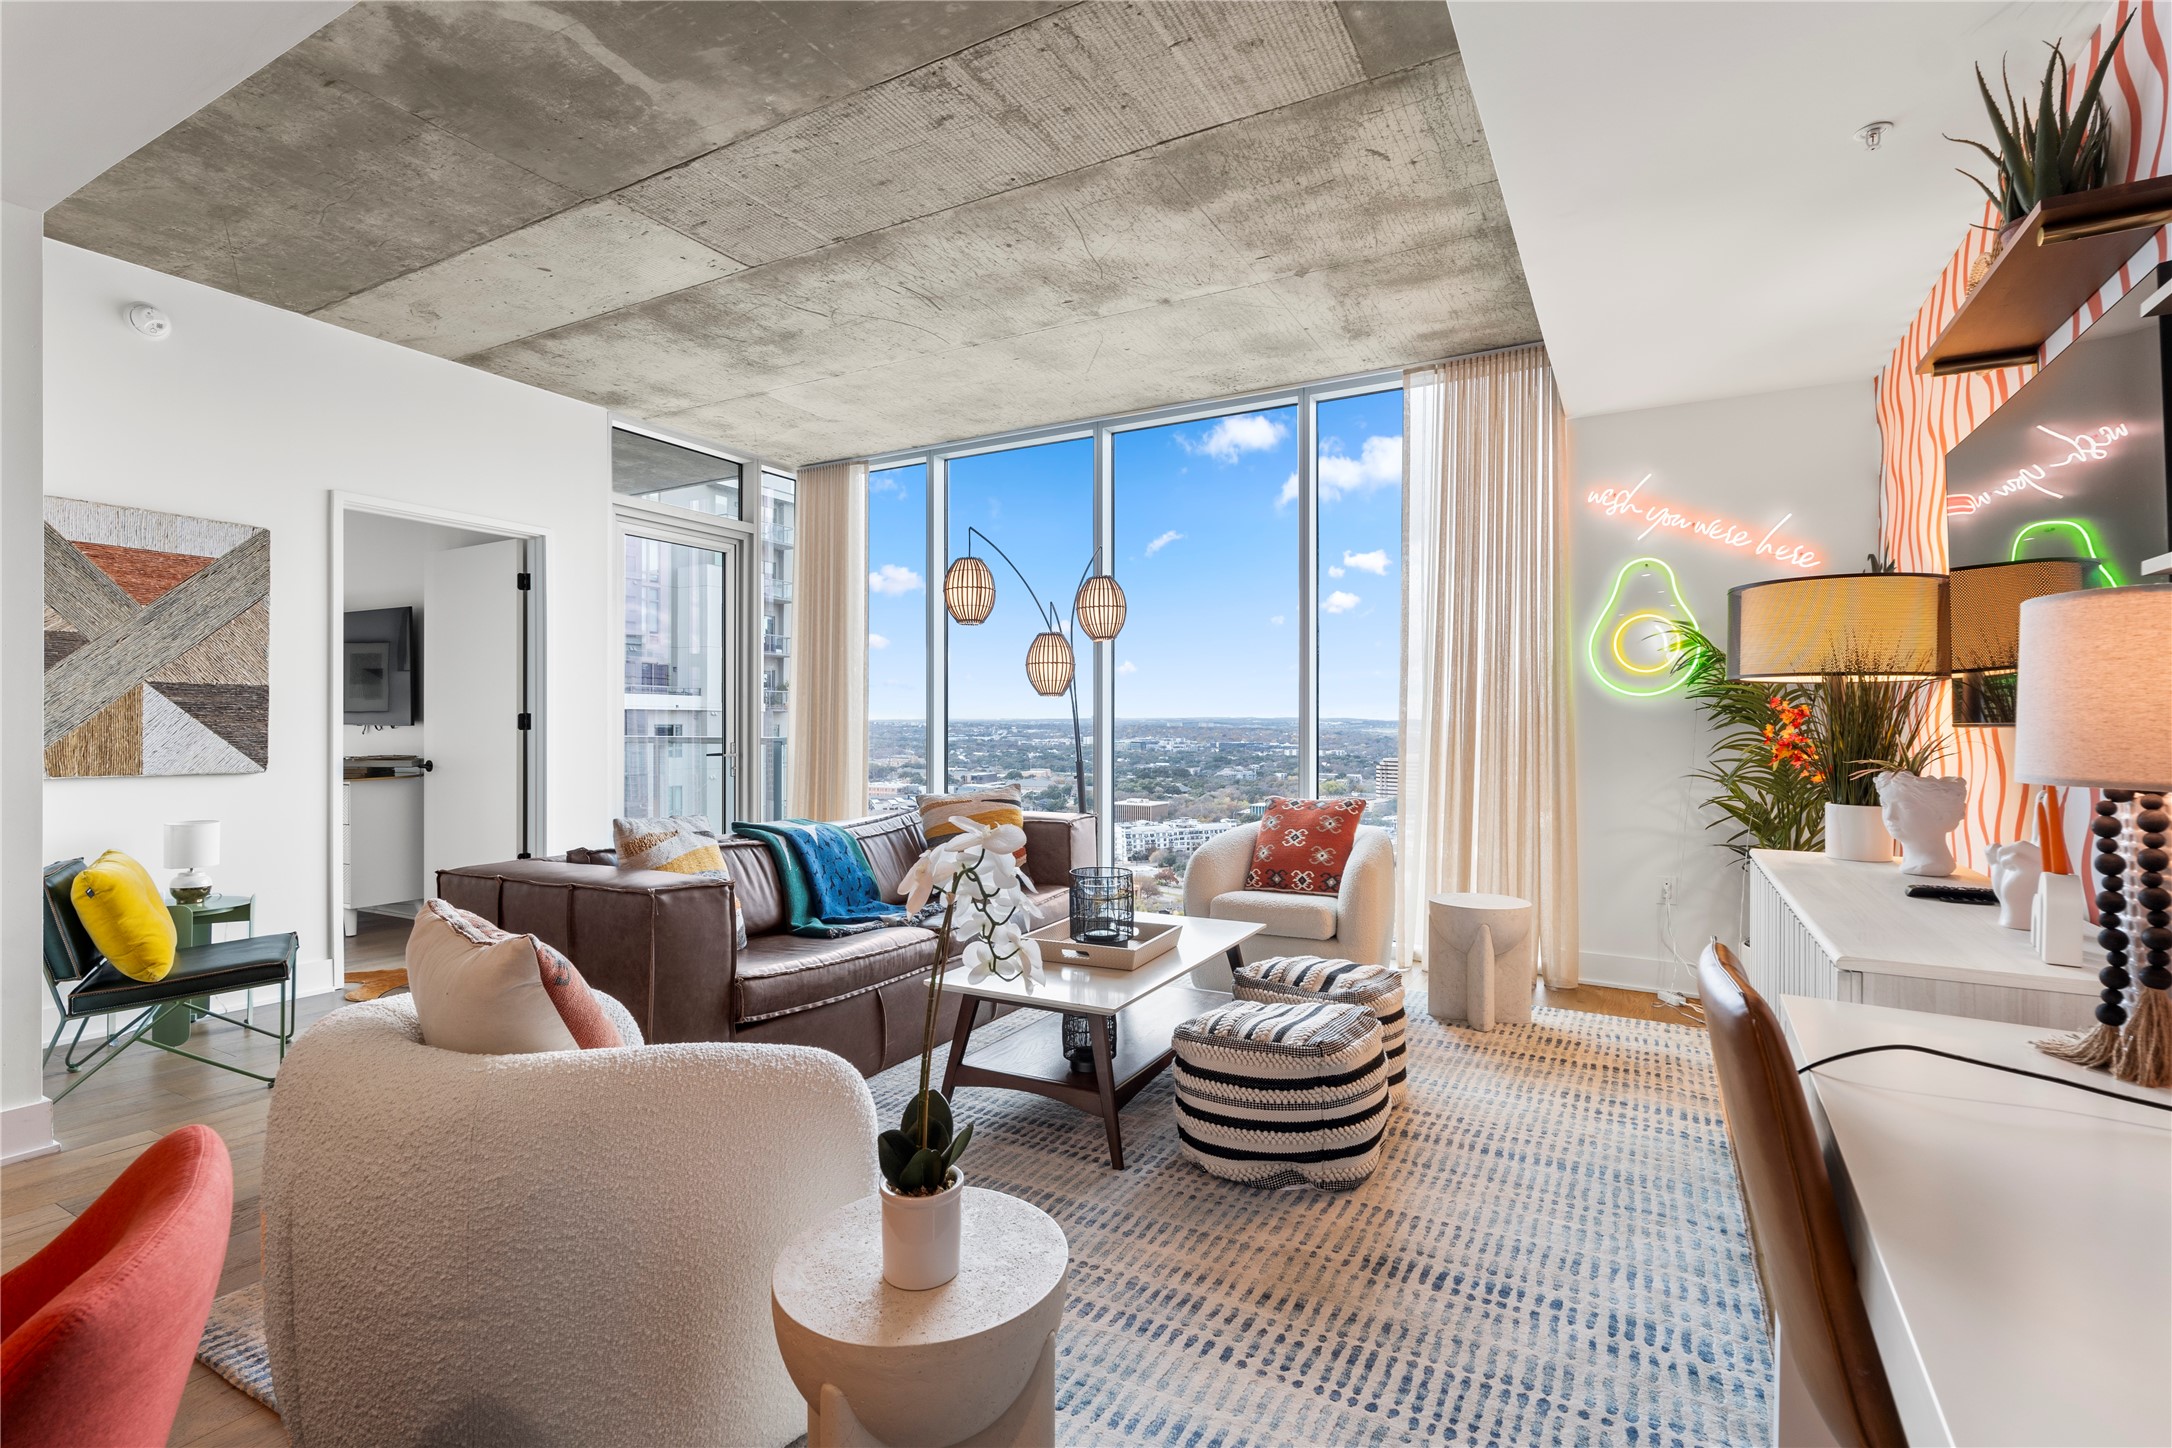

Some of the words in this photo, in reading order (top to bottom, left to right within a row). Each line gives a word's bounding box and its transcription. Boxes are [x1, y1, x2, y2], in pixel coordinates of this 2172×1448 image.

[1587, 473, 1652, 516] wish
[1638, 505, 1693, 541] you
[1693, 518, 1752, 547] were
[1755, 512, 1822, 568] here
